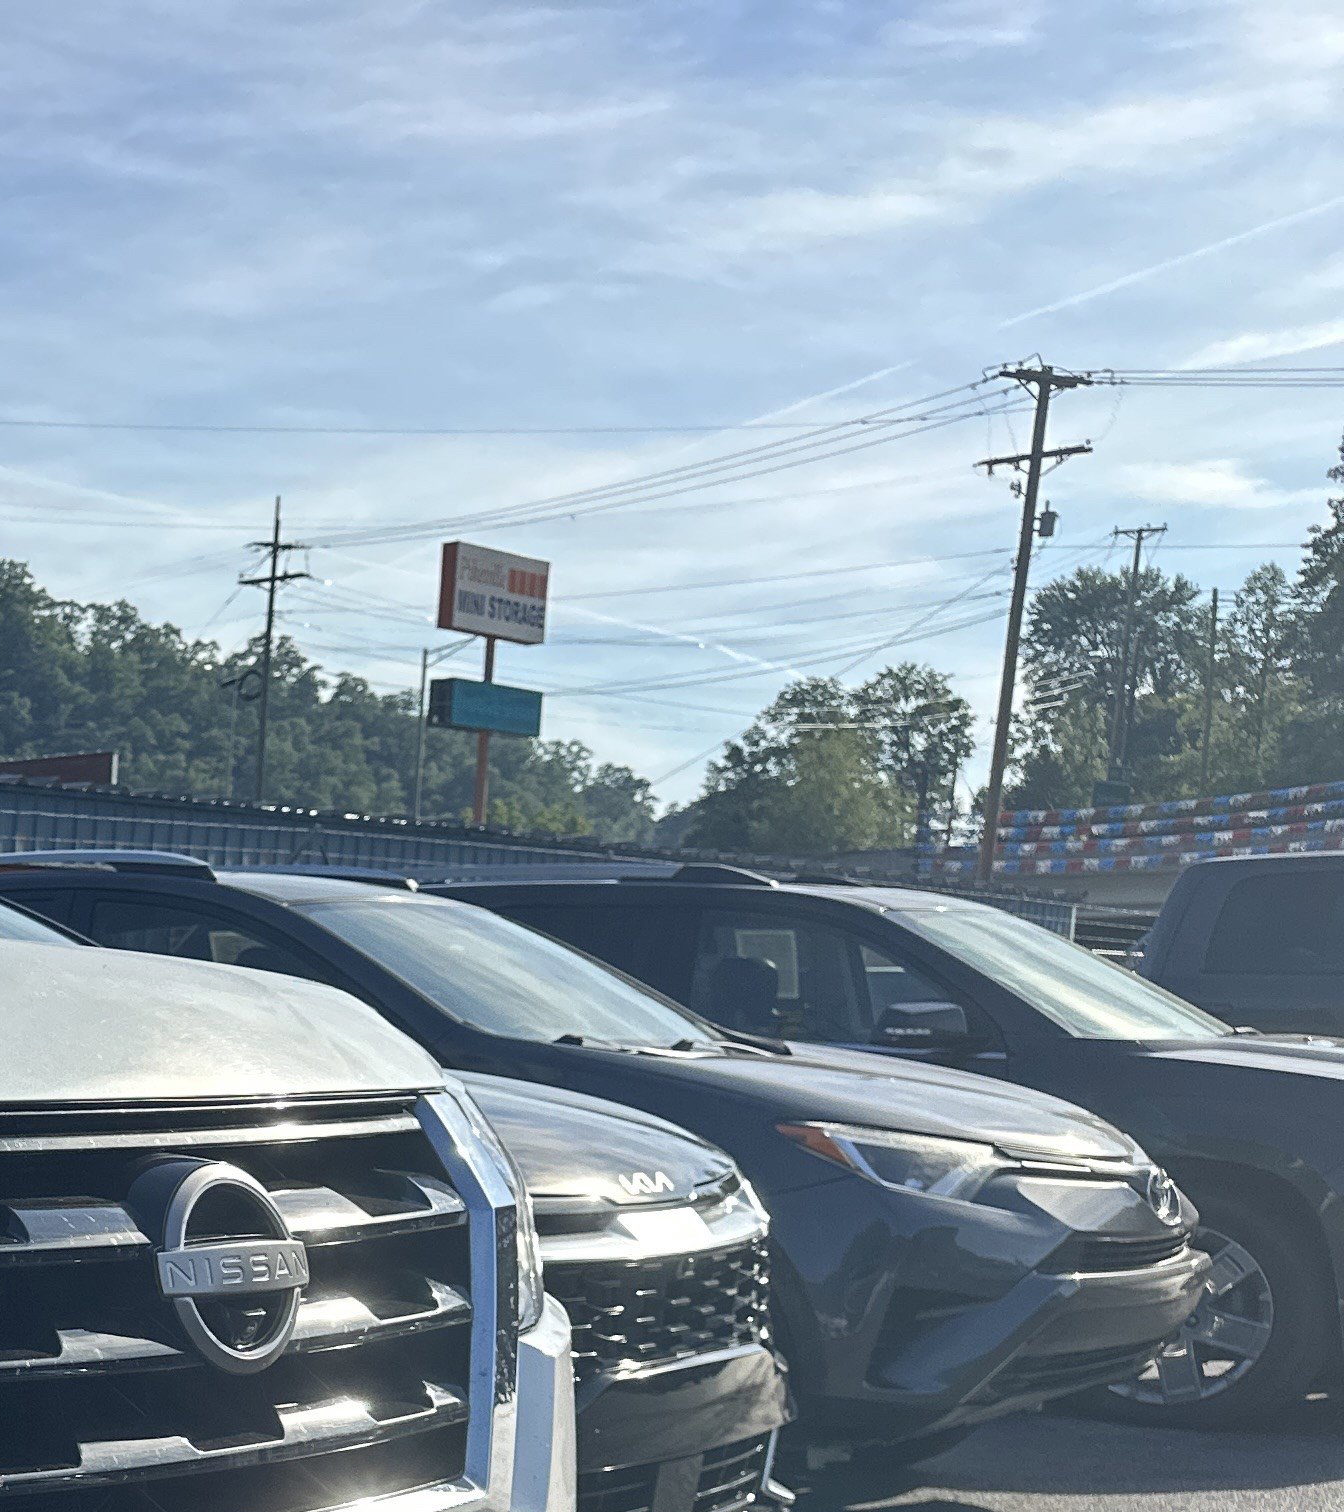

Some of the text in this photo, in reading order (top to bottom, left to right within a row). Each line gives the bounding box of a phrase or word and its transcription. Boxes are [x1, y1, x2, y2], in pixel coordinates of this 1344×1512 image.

[458, 589, 545, 629] MINI STORAGE
[165, 1250, 308, 1288] NISSAN
